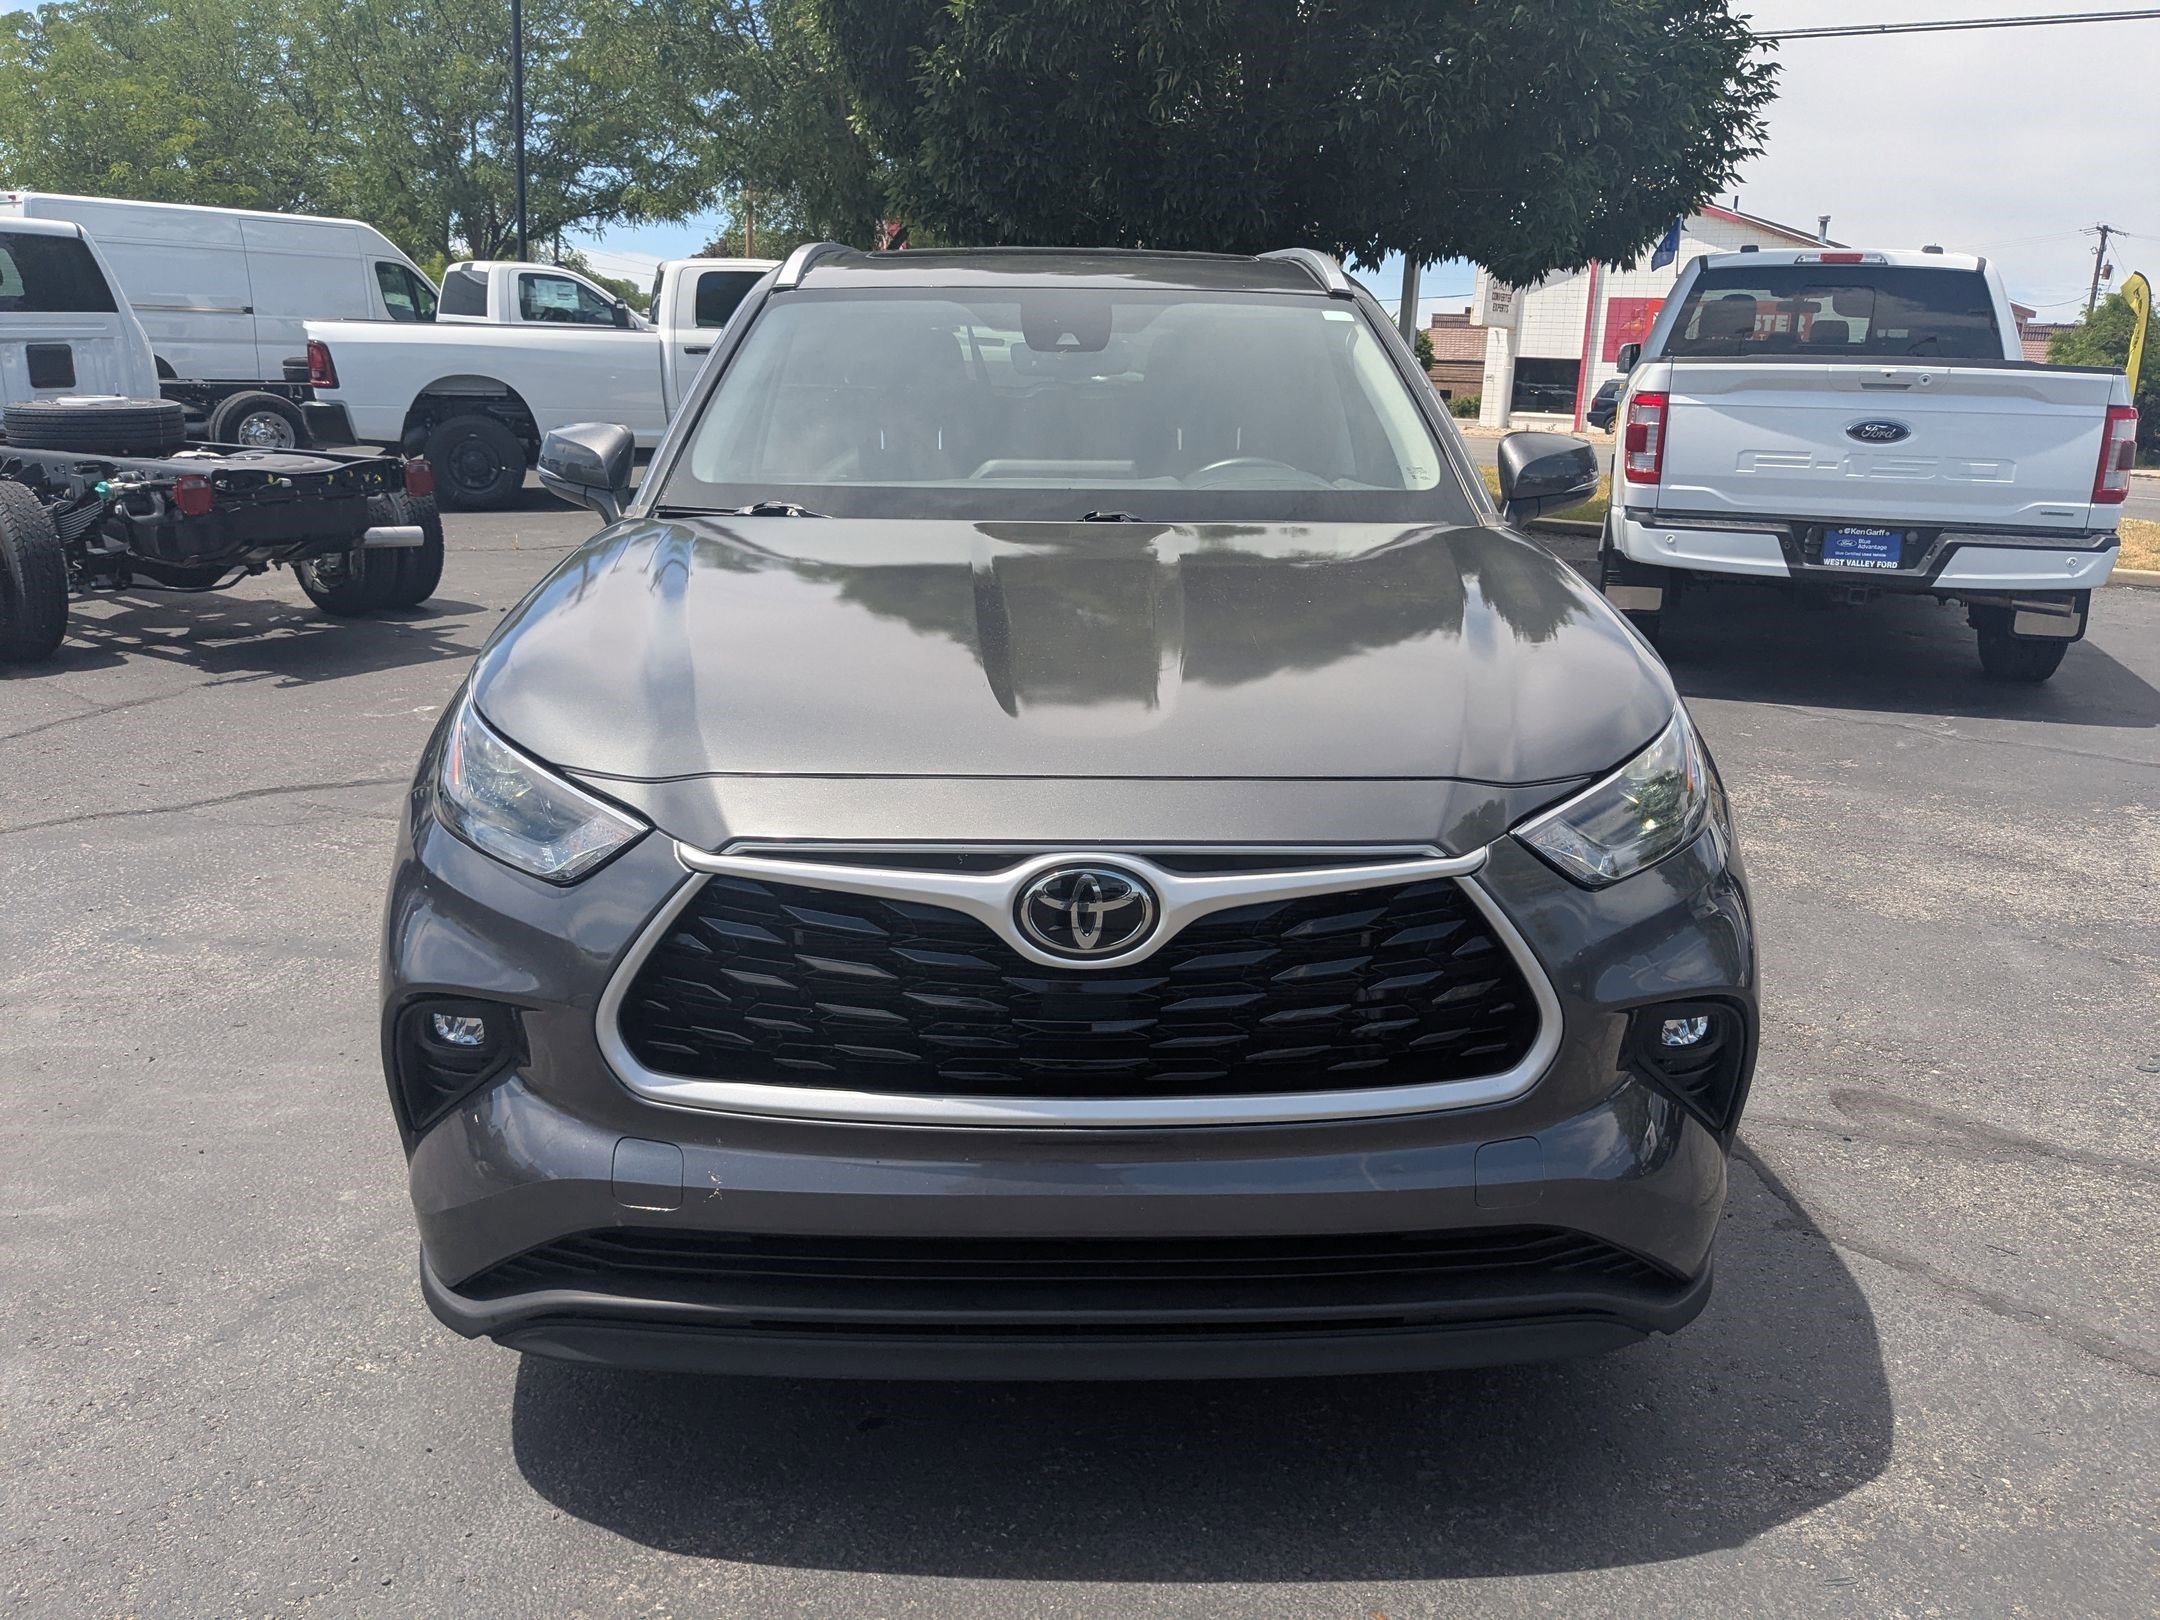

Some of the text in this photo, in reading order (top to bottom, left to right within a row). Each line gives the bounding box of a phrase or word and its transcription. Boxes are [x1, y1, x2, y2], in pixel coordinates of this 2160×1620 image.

[1860, 423, 1896, 440] Ford
[1735, 449, 2017, 483] F-150
[1866, 528, 1885, 536] Garff
[1823, 558, 1898, 569] WEST VALLEY FORD
